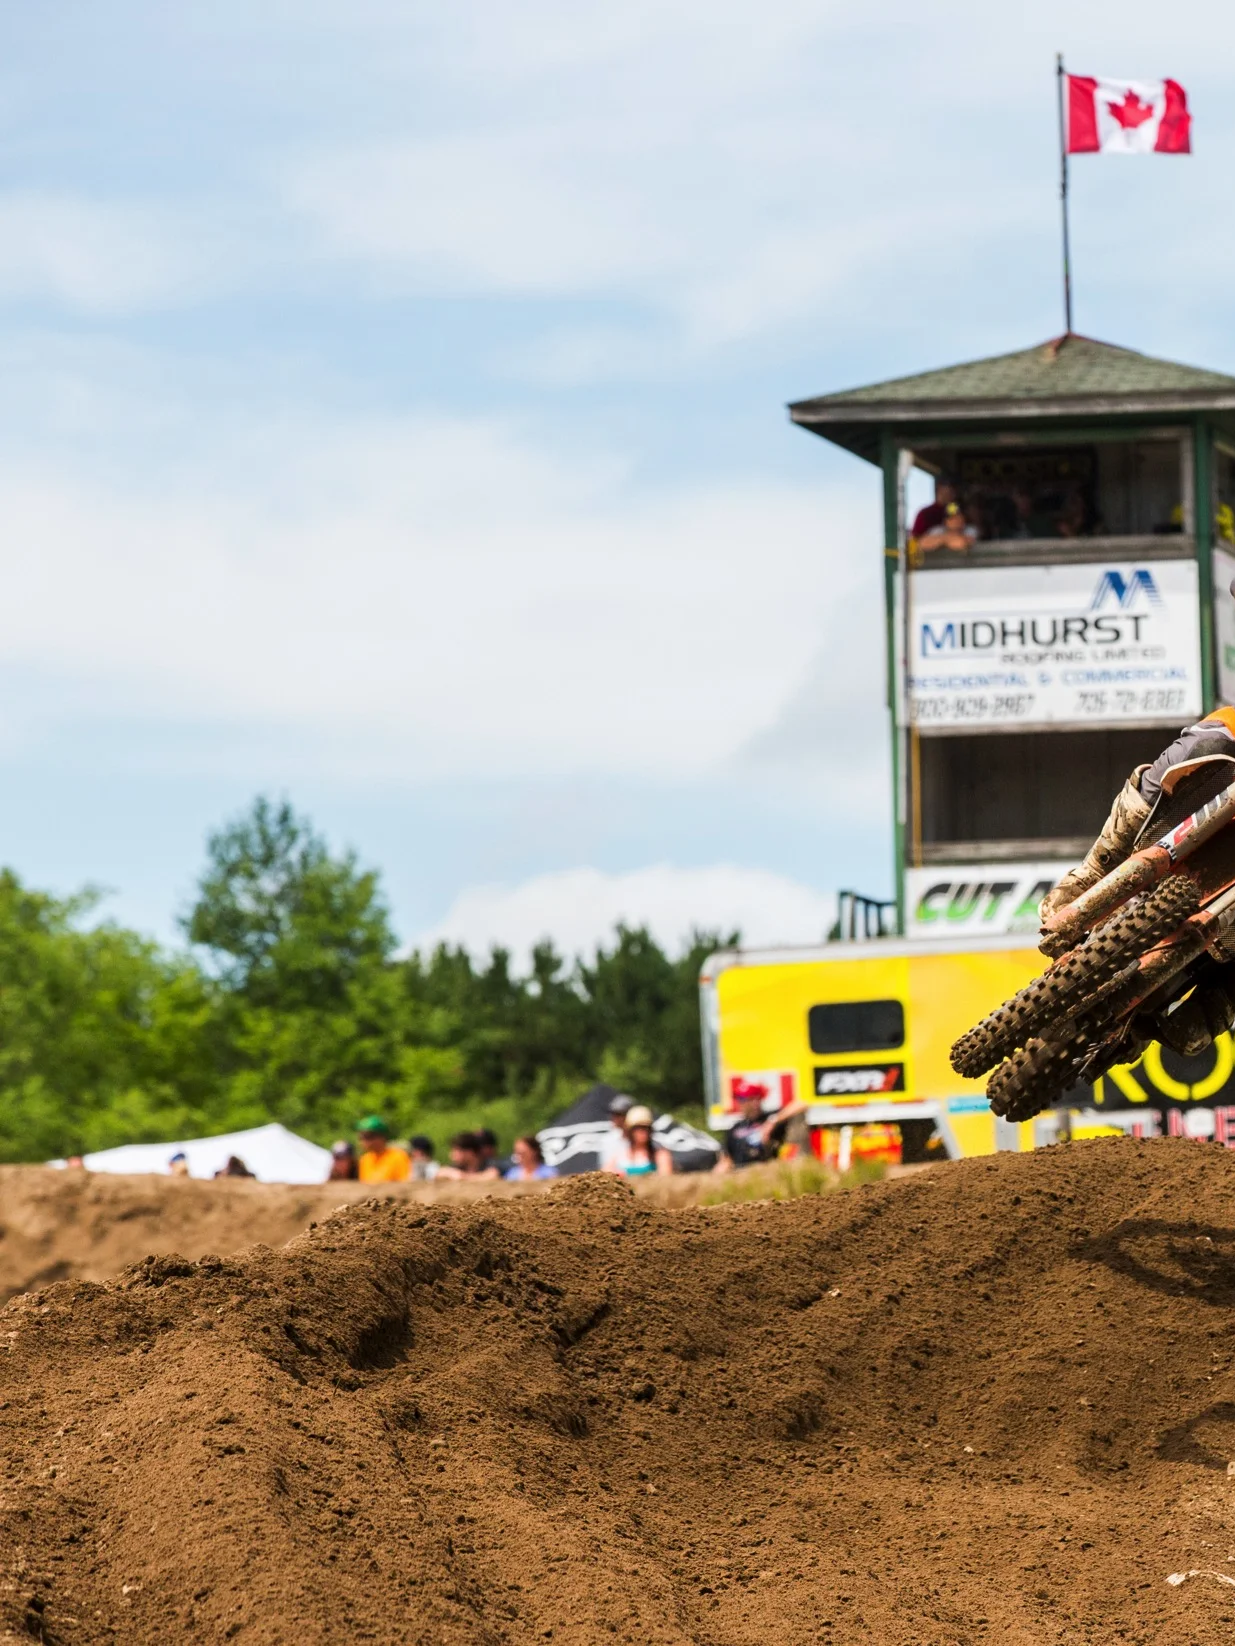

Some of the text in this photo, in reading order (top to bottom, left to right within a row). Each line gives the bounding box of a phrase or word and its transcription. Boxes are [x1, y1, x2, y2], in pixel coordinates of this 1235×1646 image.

[921, 613, 1149, 656] MIDHURST
[1092, 647, 1166, 662] LIMITED
[908, 672, 1029, 690] RESIDENTIAL
[1061, 667, 1191, 685] COMMERCIAL
[915, 882, 1019, 922] CUT
